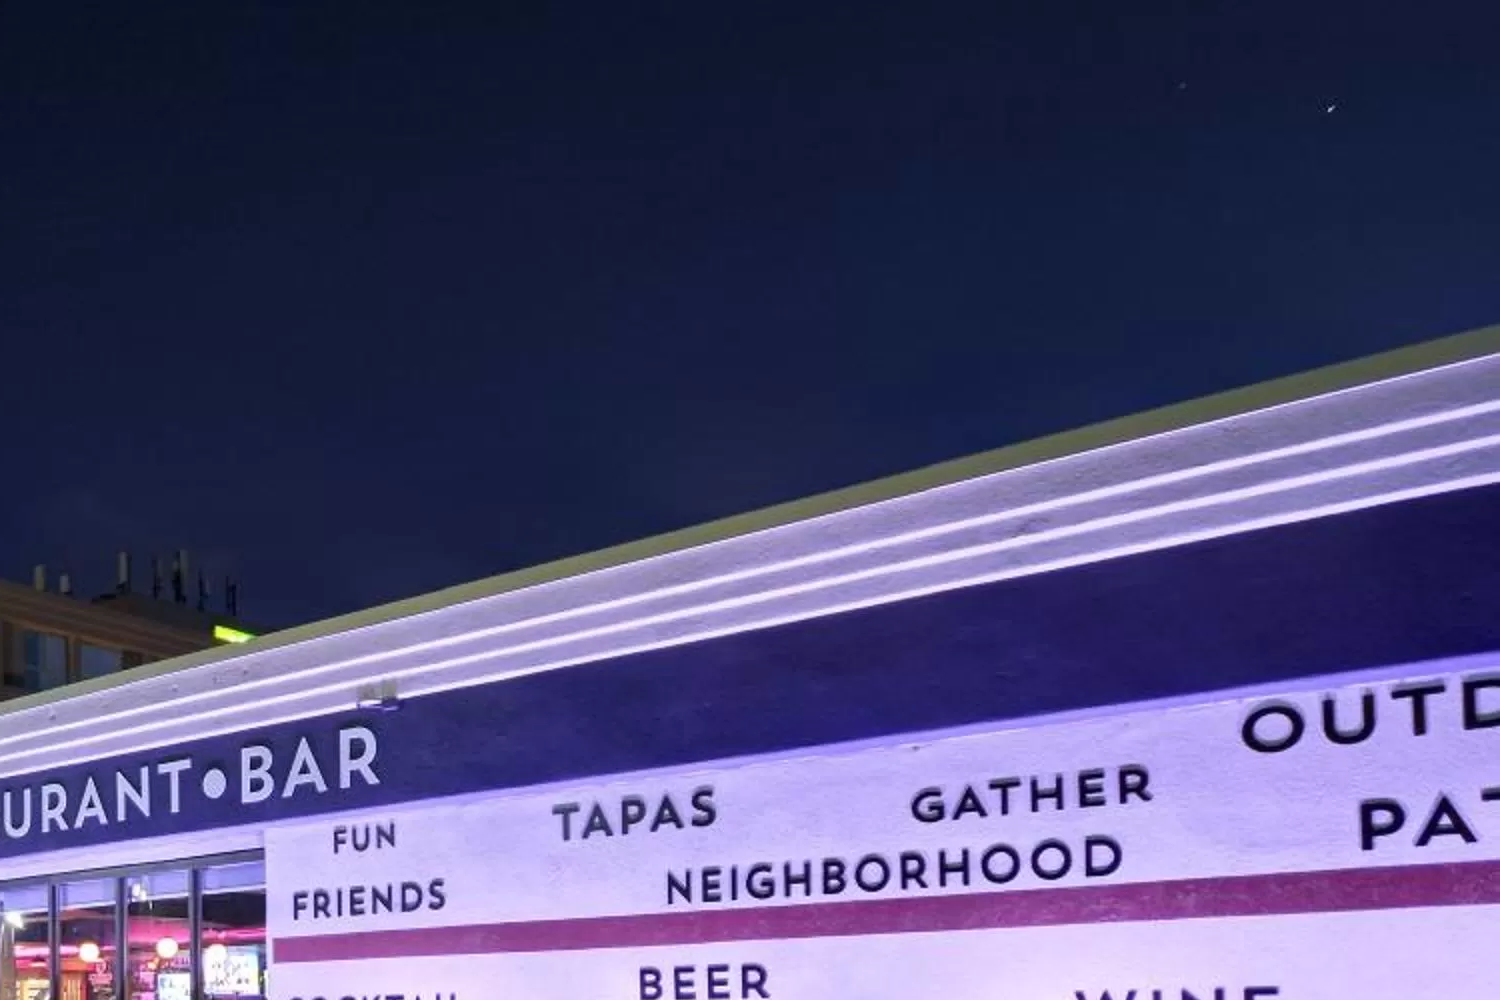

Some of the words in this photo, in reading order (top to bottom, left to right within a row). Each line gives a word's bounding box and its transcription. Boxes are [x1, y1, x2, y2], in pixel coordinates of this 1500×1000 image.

[240, 726, 381, 805] BAR
[910, 761, 1154, 824] GATHER
[333, 822, 396, 855] FUN
[551, 786, 718, 842] TAPAS
[666, 833, 1124, 906] NEIGHBORHOOD
[292, 877, 447, 922] FRIENDS
